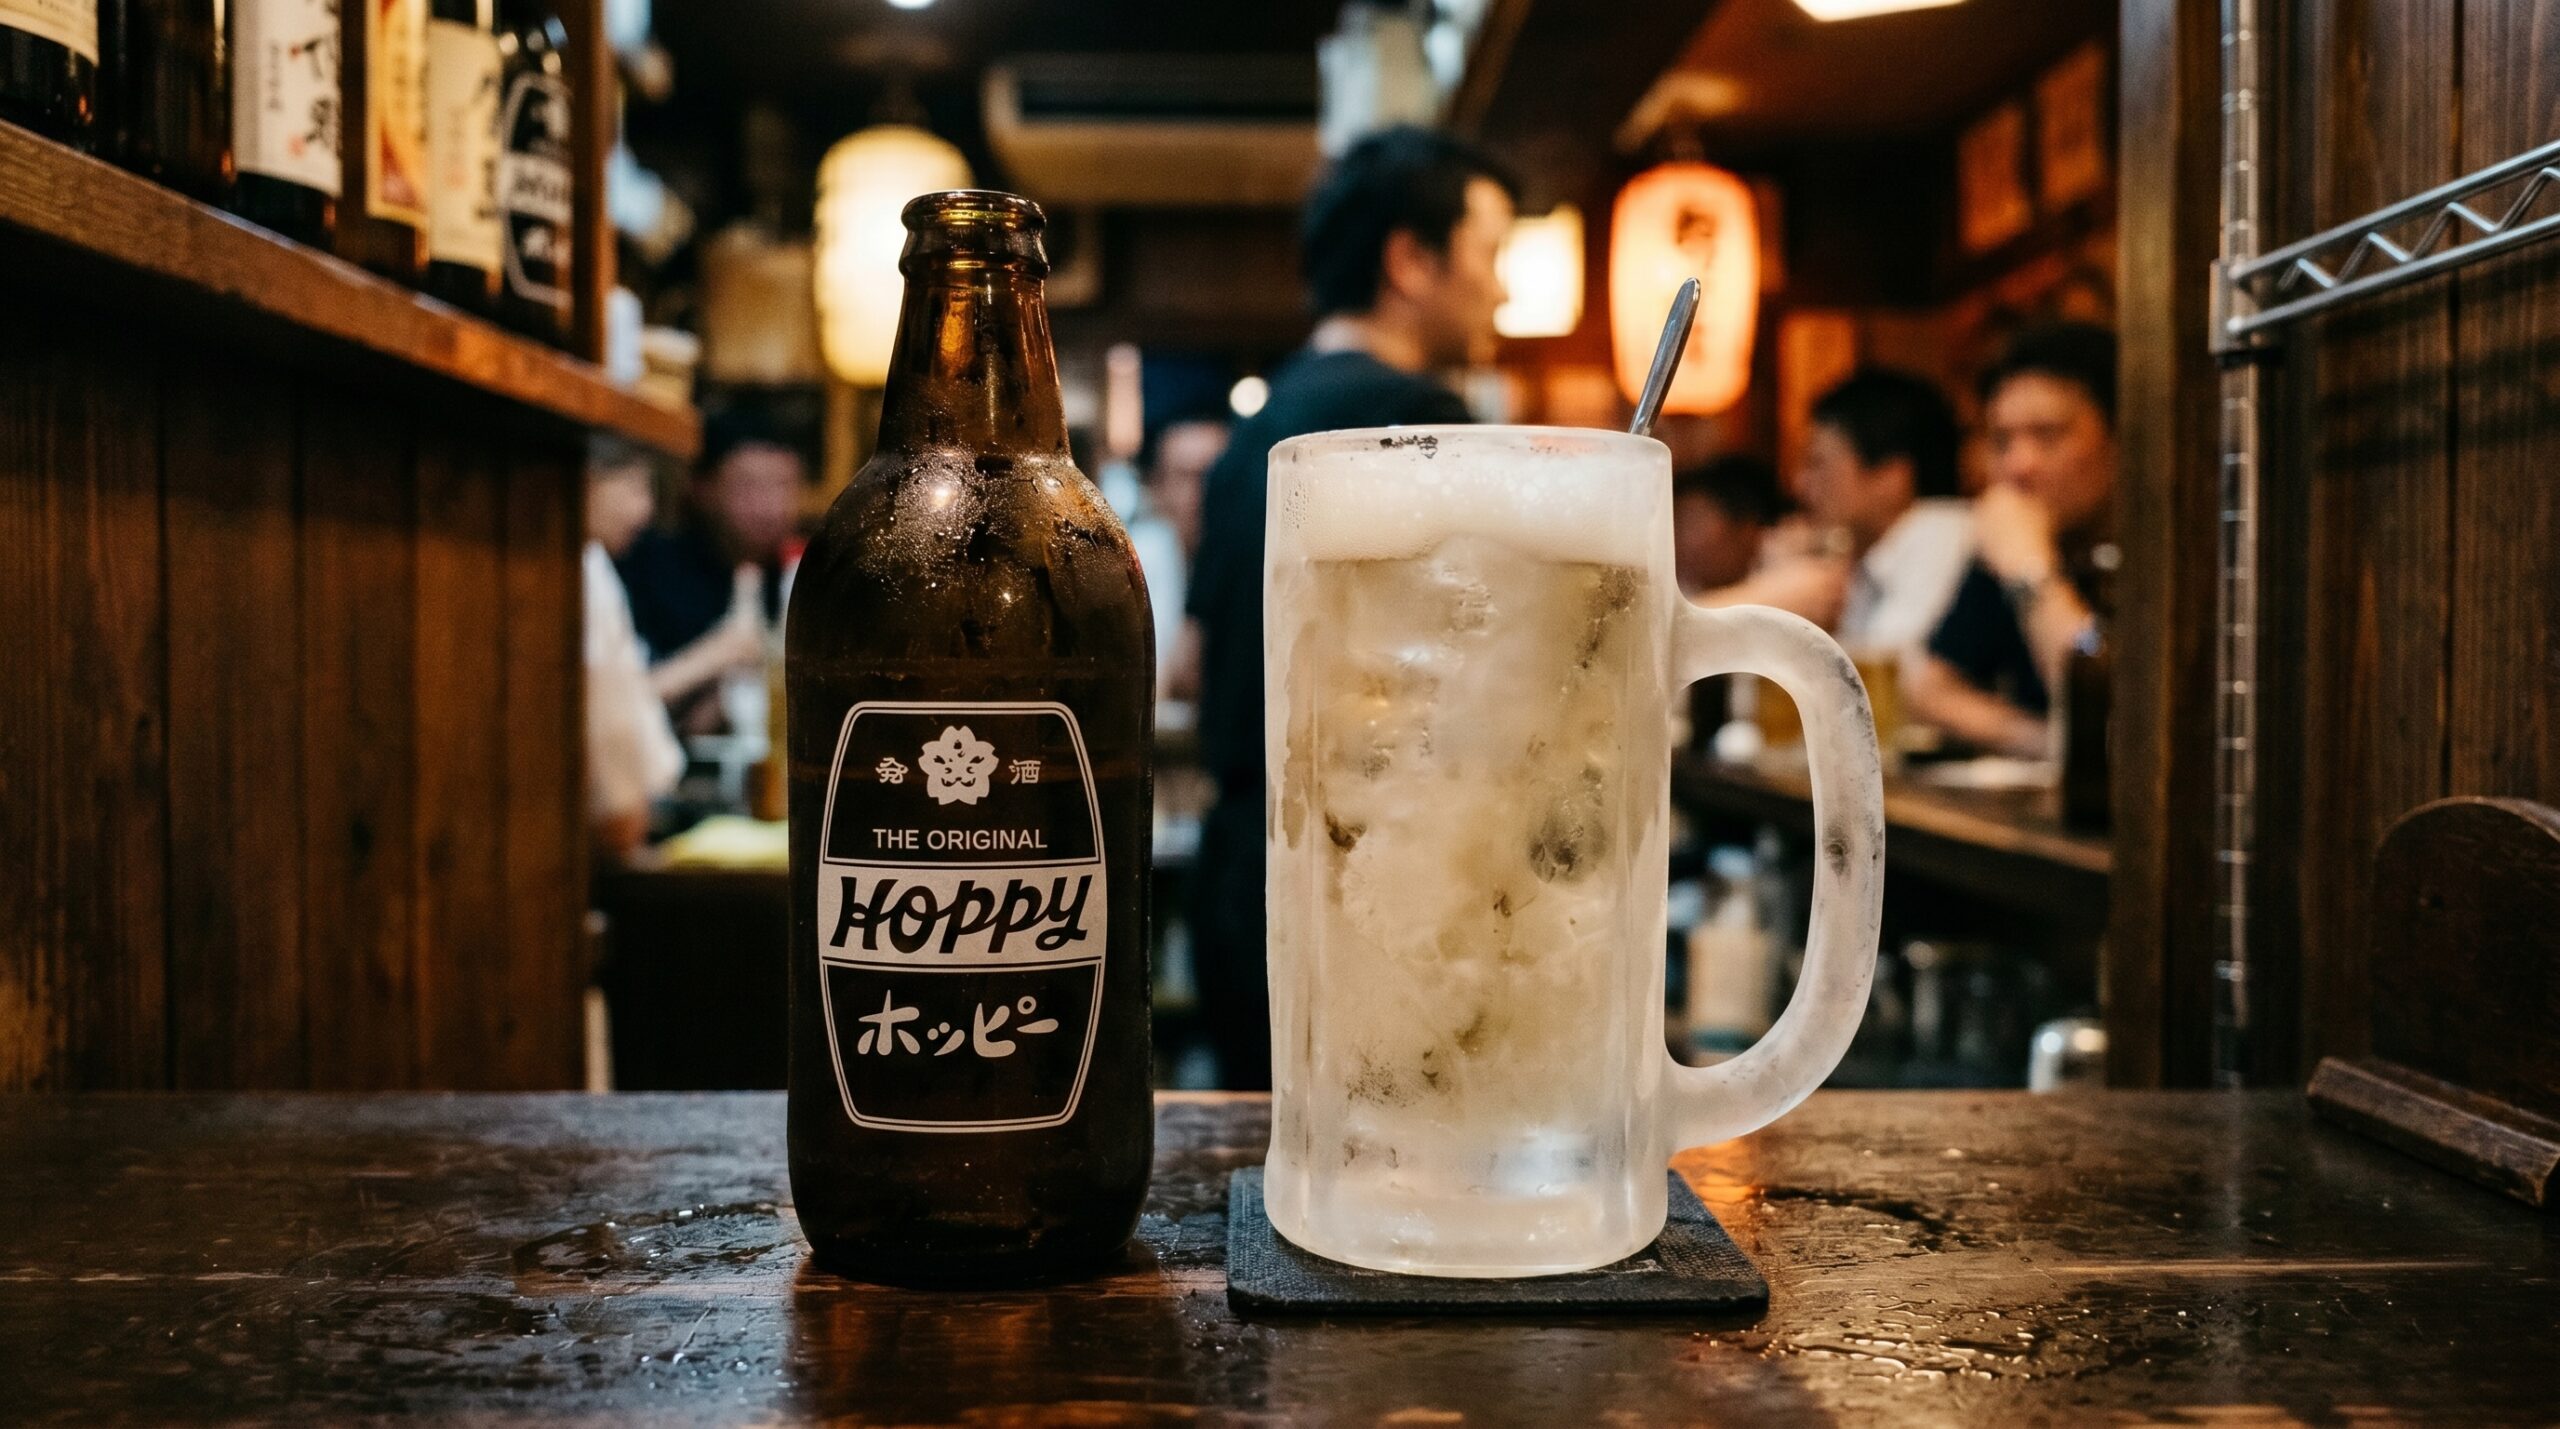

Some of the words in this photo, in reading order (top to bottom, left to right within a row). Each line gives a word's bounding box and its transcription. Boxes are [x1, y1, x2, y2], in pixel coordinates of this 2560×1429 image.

[1008, 759, 1041, 785] 酒
[872, 828, 920, 850] THE
[927, 829, 1048, 850] ORIGINAL
[857, 989, 1059, 1058] ホッピー
